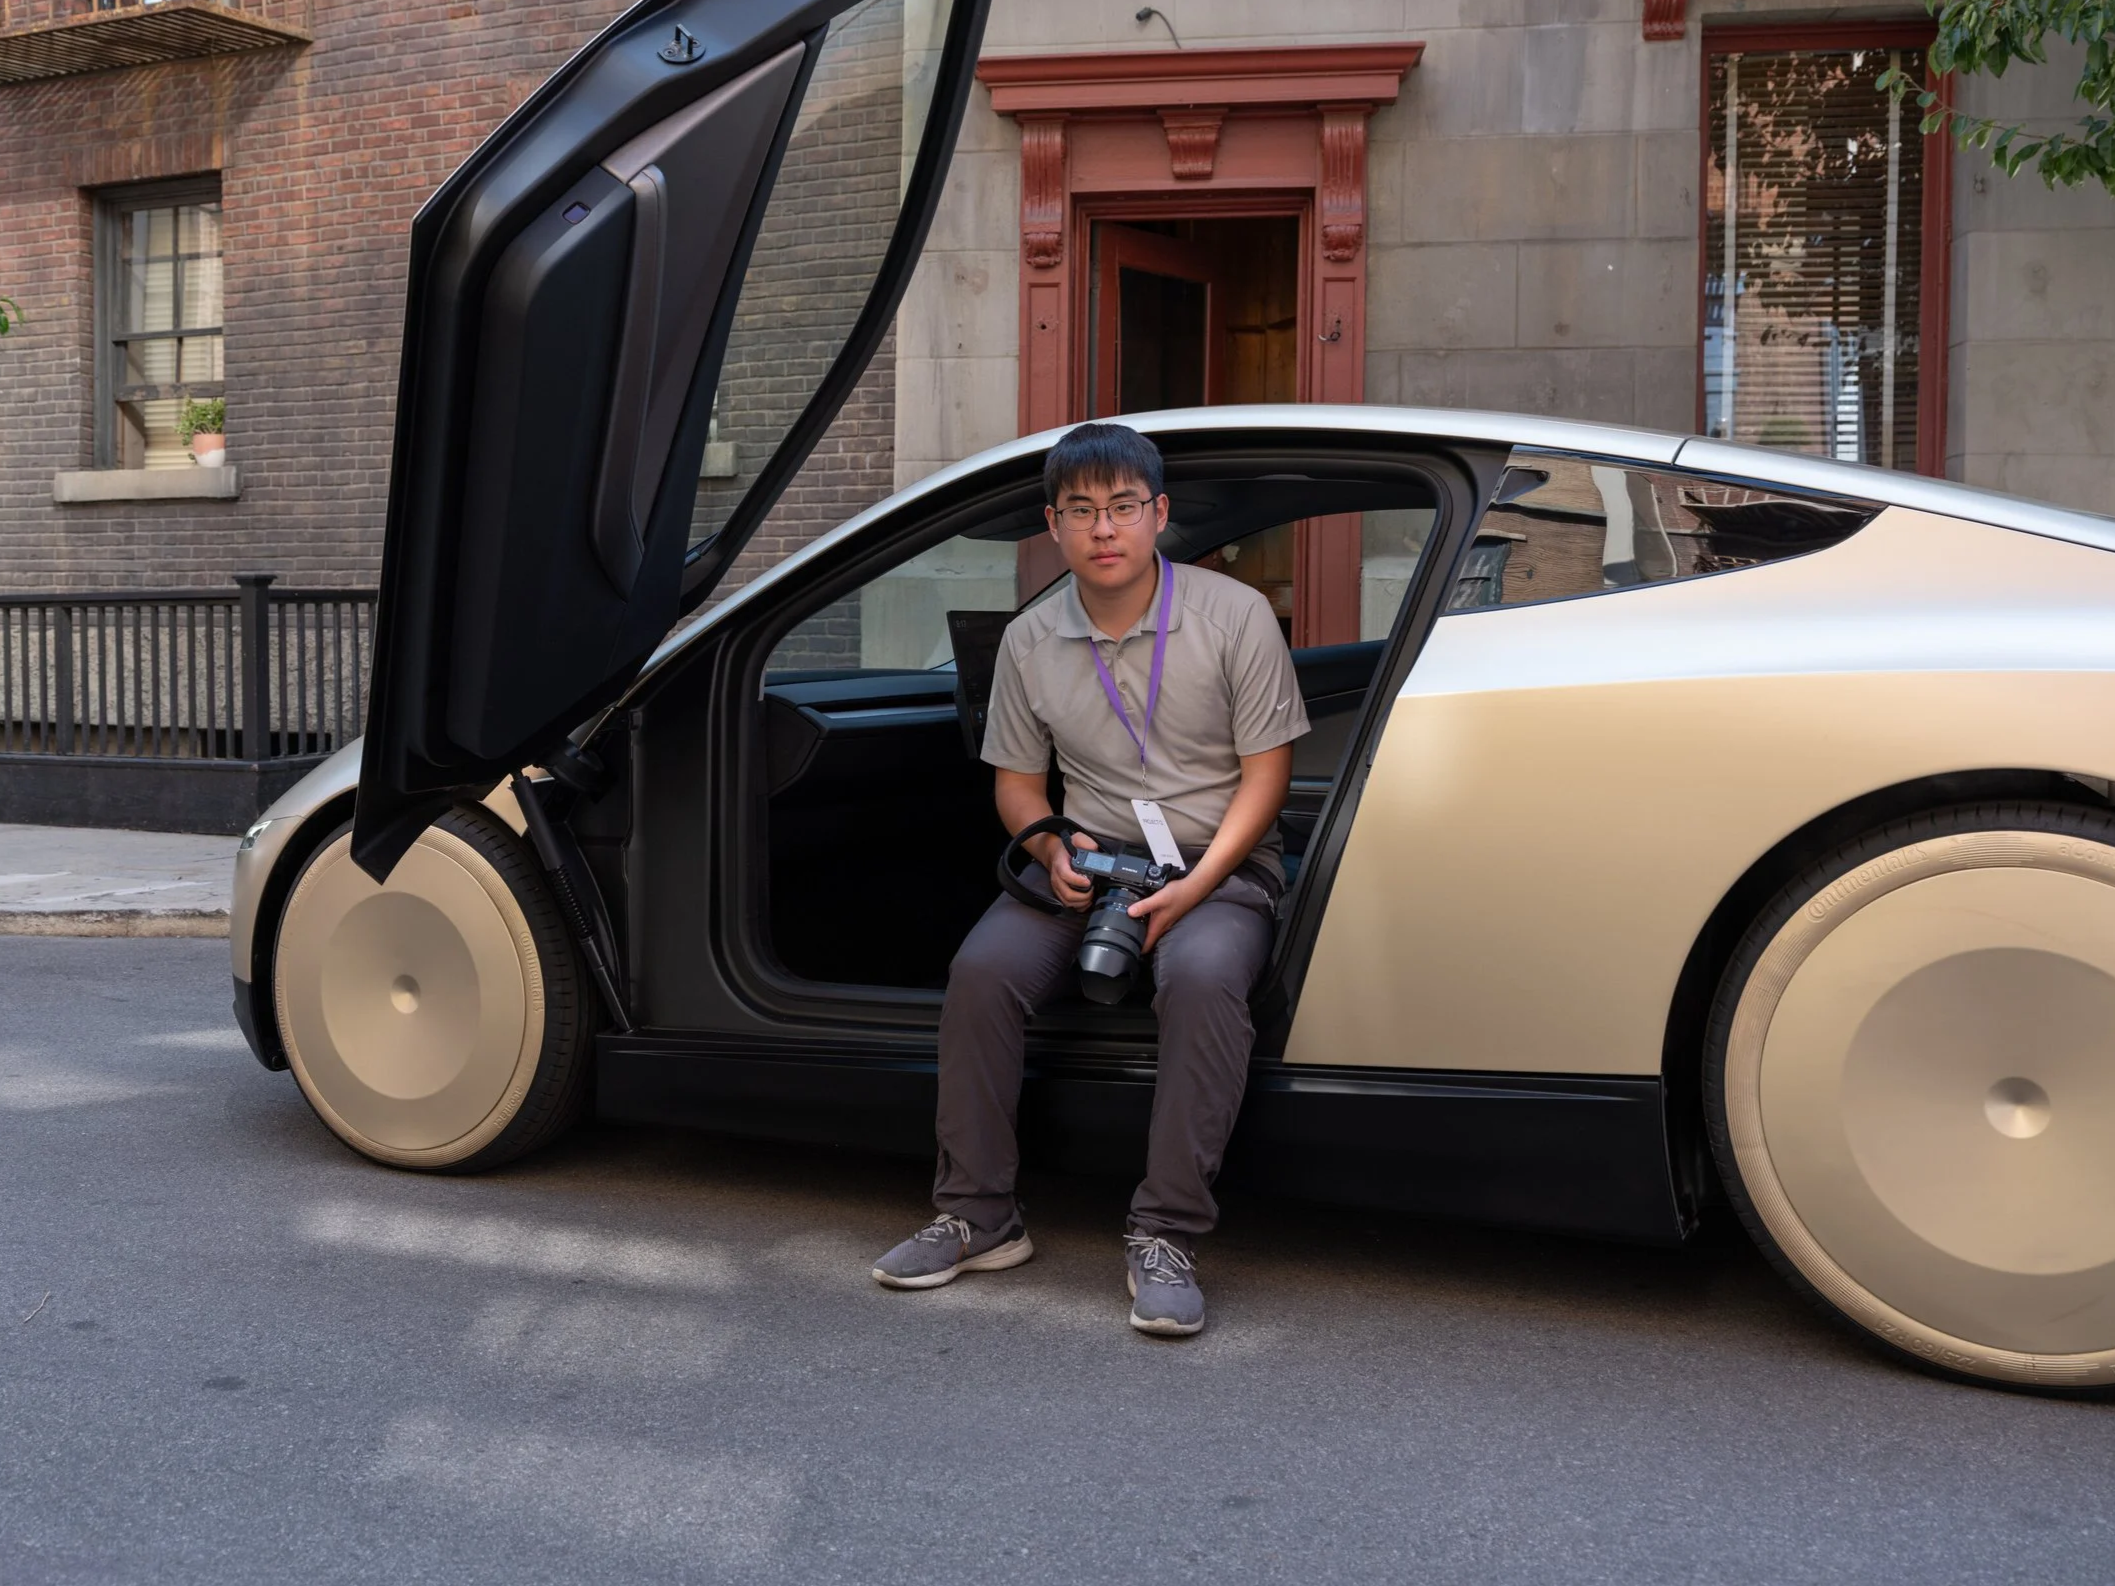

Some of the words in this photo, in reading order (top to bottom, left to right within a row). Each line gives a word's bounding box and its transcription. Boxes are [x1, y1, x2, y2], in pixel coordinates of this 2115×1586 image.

[1805, 847, 1909, 923] Continental
[2058, 841, 2115, 869] aCon
[520, 931, 544, 1003] Continental
